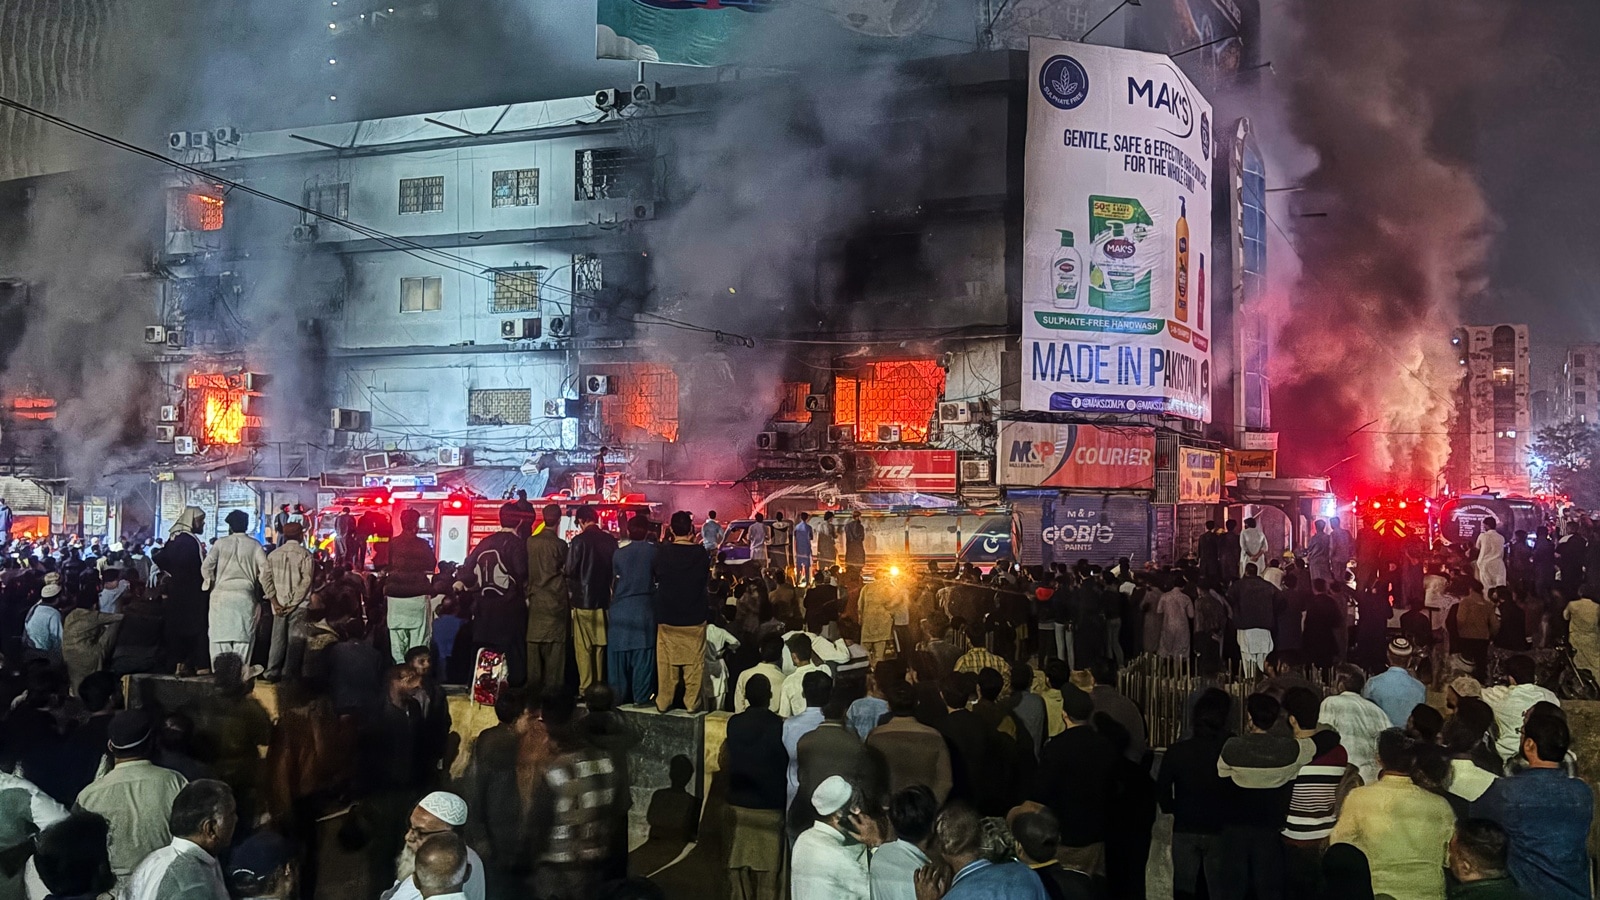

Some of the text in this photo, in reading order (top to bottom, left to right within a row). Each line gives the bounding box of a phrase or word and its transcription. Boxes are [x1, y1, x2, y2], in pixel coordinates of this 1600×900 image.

[1044, 86, 1084, 105] SULPHATE FREE
[1127, 76, 1189, 126] MAK'S
[1063, 128, 1111, 153] GENTLE,
[1113, 134, 1142, 154] SAFE
[1144, 138, 1152, 155] &
[1123, 154, 1146, 173] FOR
[1147, 156, 1167, 177] THE
[1106, 244, 1134, 254] MAK'S
[1042, 316, 1110, 328] SULPHATE-FREE
[1112, 319, 1158, 331] HANDWASH
[1032, 341, 1197, 395] MADE IN PAKISTAN
[1009, 440, 1055, 463] M&P
[1075, 447, 1152, 466] COURIER
[878, 465, 914, 479] TCS
[1077, 508, 1085, 518] &
[1064, 543, 1092, 551] PAINTS
